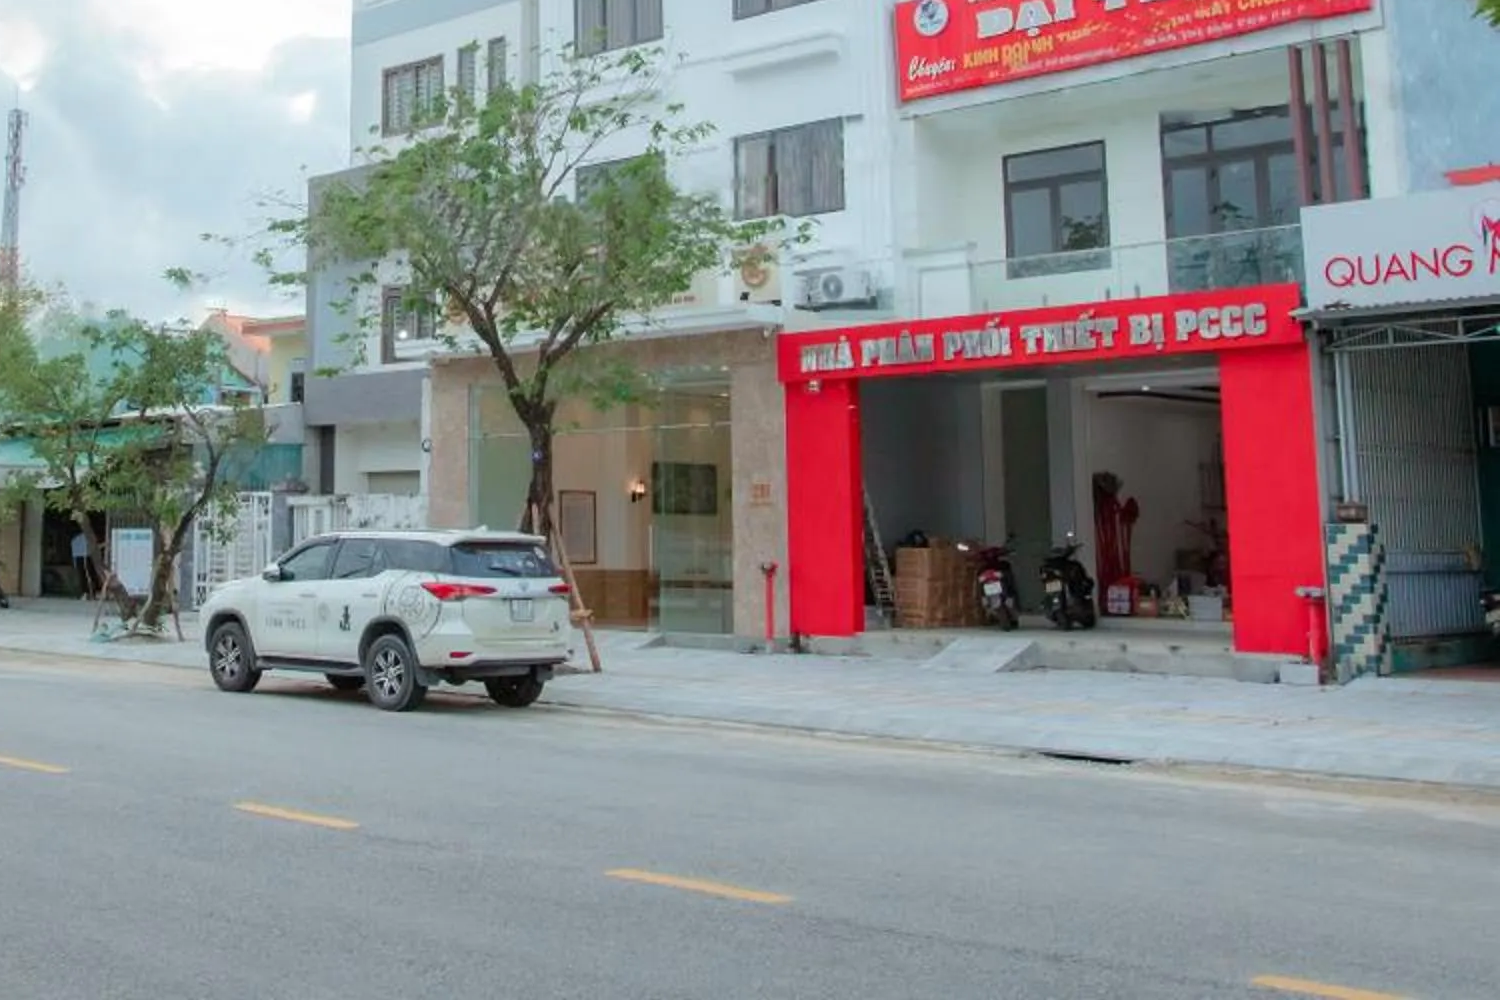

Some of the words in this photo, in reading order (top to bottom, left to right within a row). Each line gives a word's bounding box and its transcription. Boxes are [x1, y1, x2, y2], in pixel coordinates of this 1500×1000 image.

[1325, 244, 1474, 287] QUANG
[801, 334, 854, 373] NHÀ
[861, 329, 934, 367] PHÂN
[942, 317, 1012, 360] PHỐI
[1020, 309, 1119, 354] THIẾT
[1128, 314, 1166, 351] BỊ
[1175, 303, 1267, 342] PCCC
